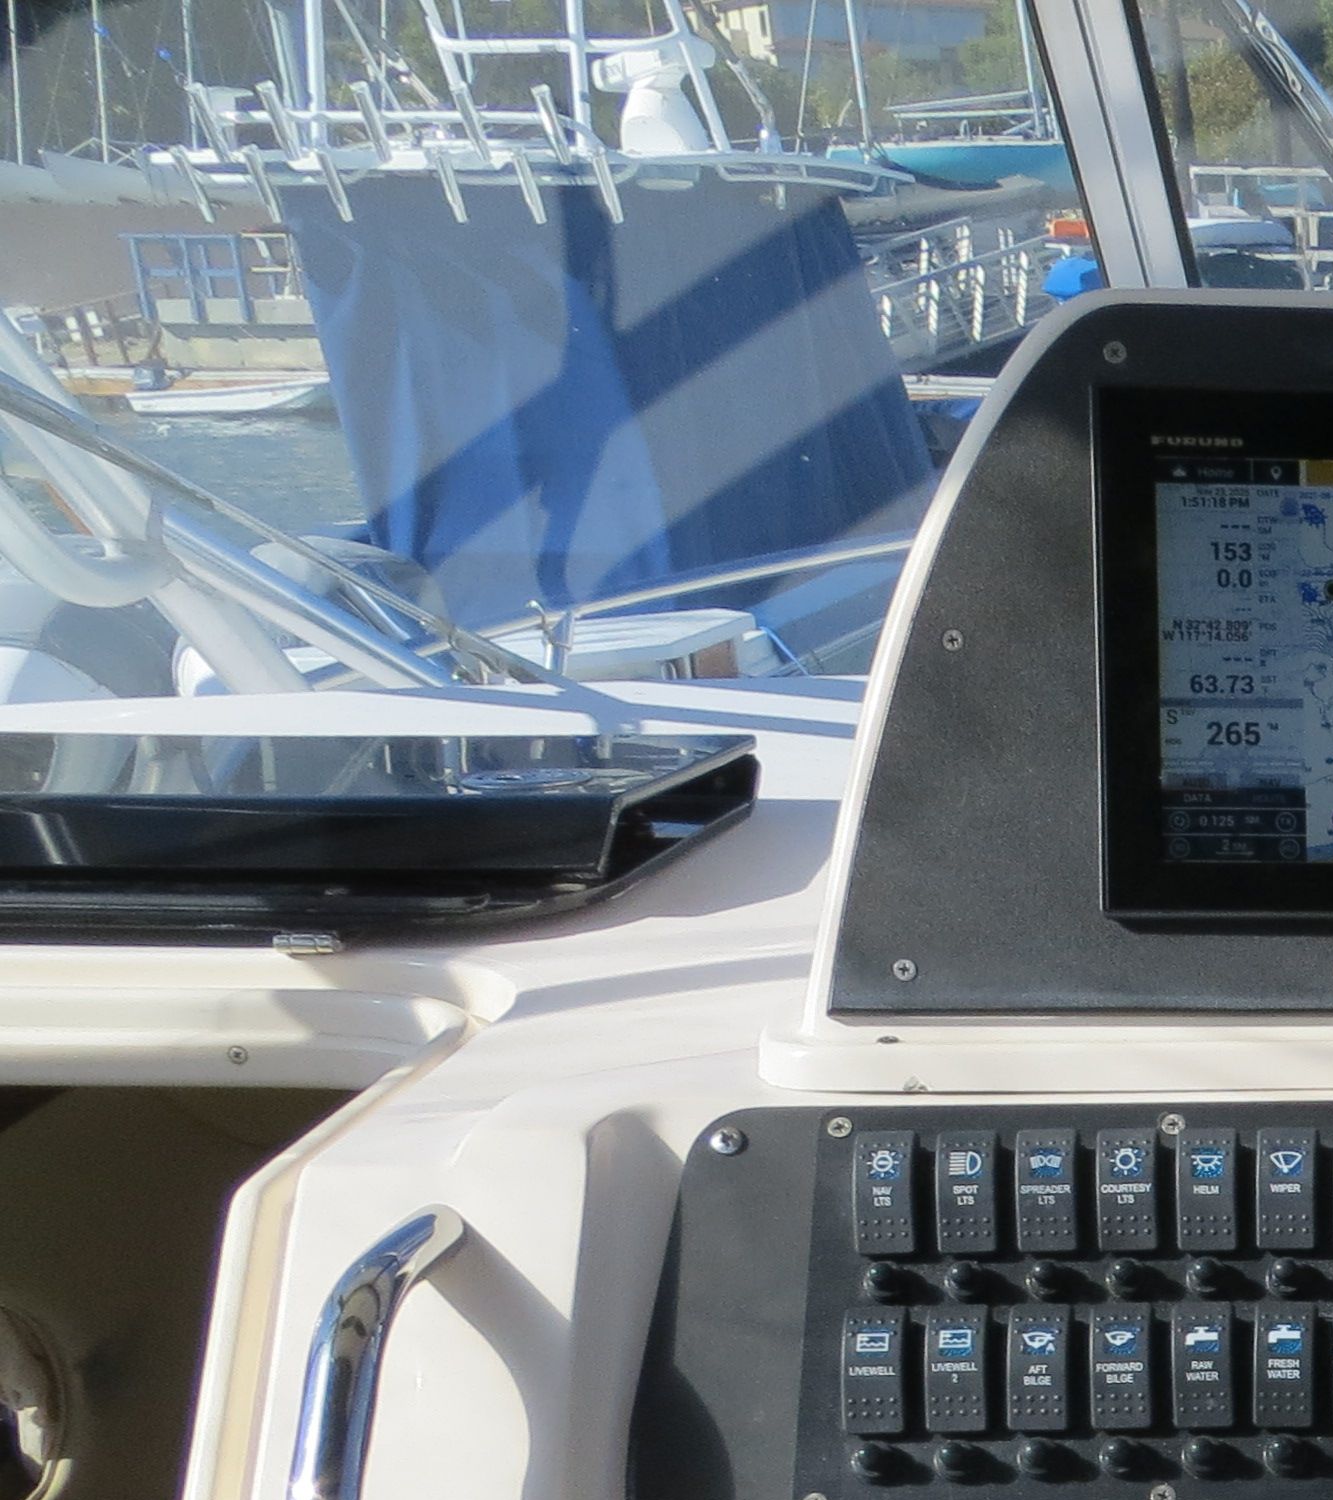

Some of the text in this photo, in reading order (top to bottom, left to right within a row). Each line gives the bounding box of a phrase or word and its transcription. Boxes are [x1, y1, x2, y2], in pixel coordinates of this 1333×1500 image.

[1150, 435, 1244, 448] FURUNO
[1181, 497, 1250, 508] 1:51:18 PM
[1210, 541, 1252, 561] 153
[1217, 568, 1252, 588] 0.0
[1172, 620, 1183, 630] N
[1162, 631, 1175, 641] W
[1190, 674, 1254, 694] 63.73
[1206, 721, 1261, 746] 265
[1184, 793, 1212, 803] DATA
[1222, 840, 1230, 851] 2
[872, 1186, 893, 1196] NAV
[953, 1185, 979, 1195] SPOT
[1020, 1184, 1071, 1195] SPREADER
[1101, 1183, 1152, 1194] COURTESY
[1193, 1184, 1220, 1195] HELM
[1270, 1183, 1301, 1194] WIPER
[874, 1196, 892, 1207] LTS
[957, 1196, 975, 1206] LTS
[1038, 1195, 1056, 1206] LTS
[1117, 1194, 1135, 1204] LTS
[931, 1361, 978, 1373] LIVEWELL
[1096, 1361, 1144, 1373] FORWARD
[1191, 1361, 1214, 1371] RAW
[1268, 1358, 1300, 1369] FRESH
[849, 1366, 896, 1377] LIVEWELL
[1028, 1364, 1048, 1375] AFT
[1267, 1369, 1301, 1380] WATER
[952, 1373, 959, 1383] 2
[1024, 1375, 1052, 1386] BILGE
[1106, 1373, 1135, 1384] BILGE
[1186, 1371, 1219, 1382] WATER
